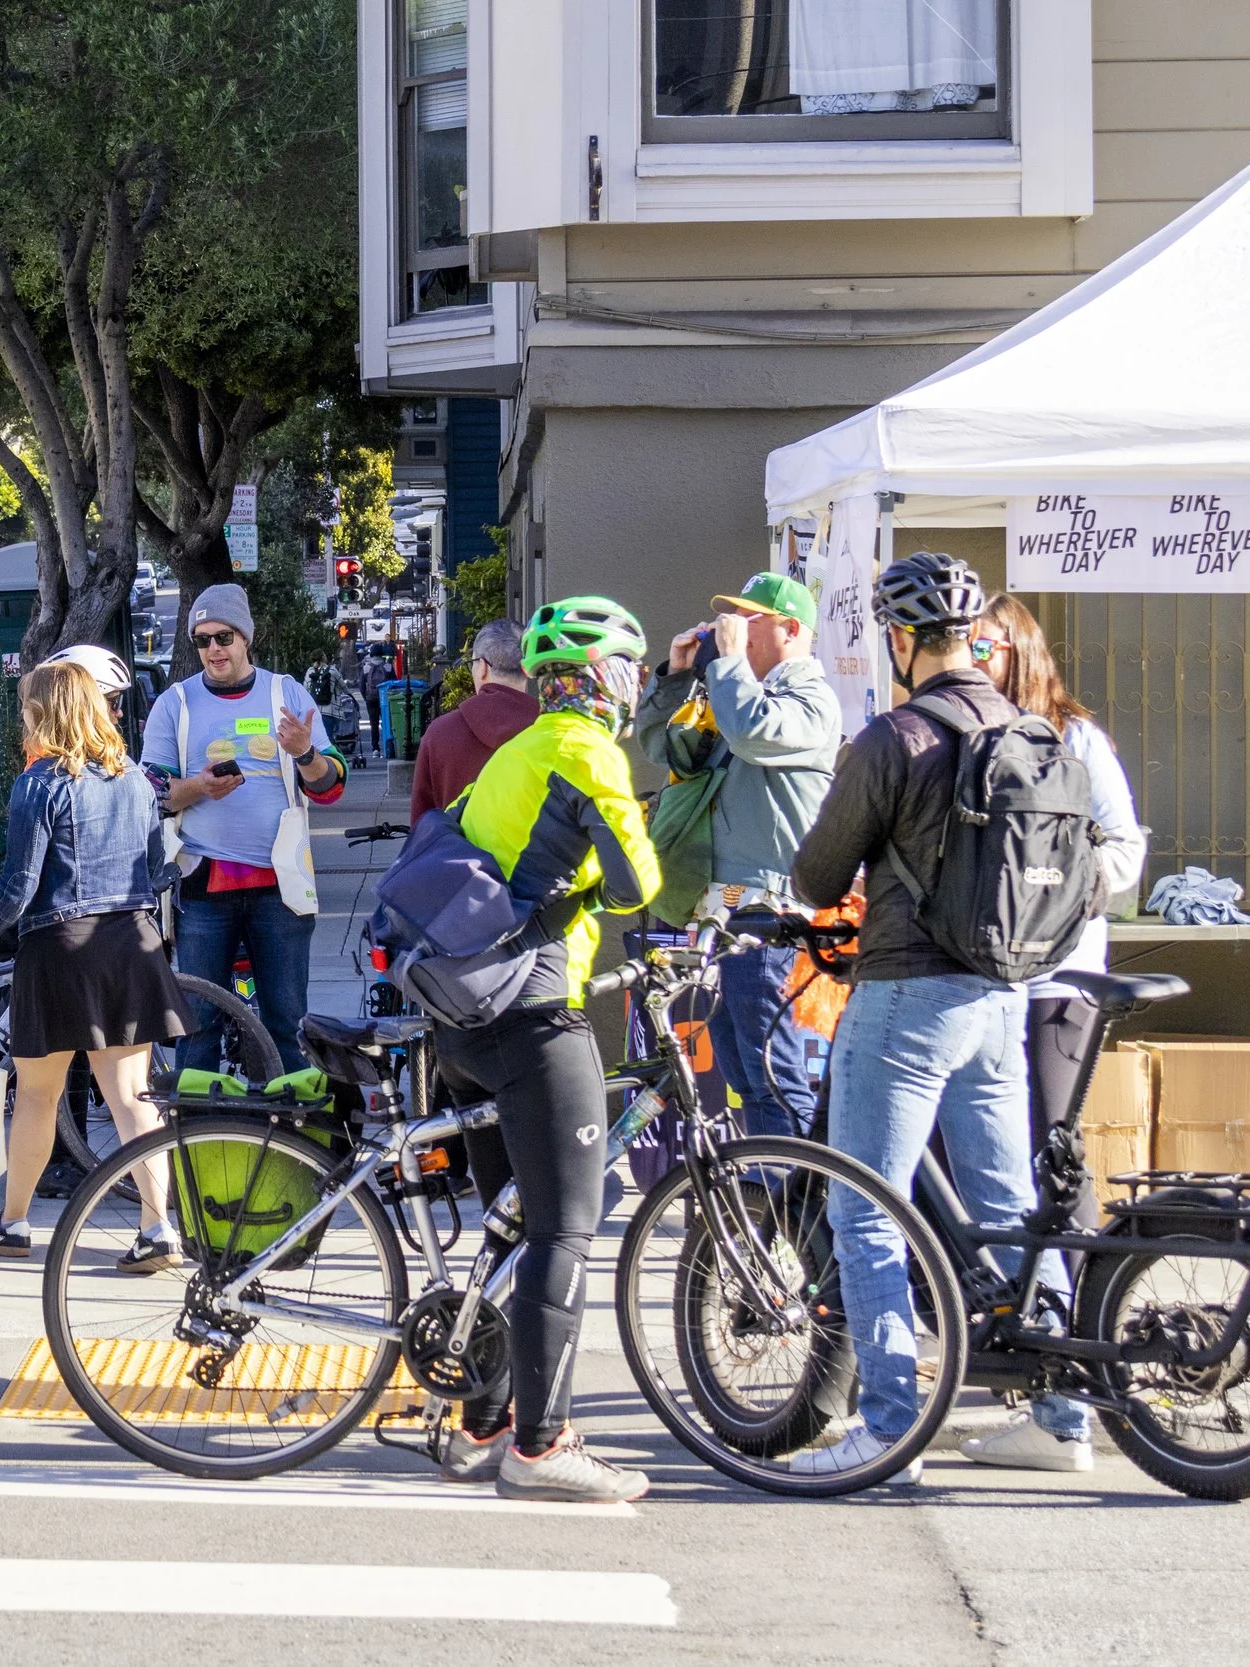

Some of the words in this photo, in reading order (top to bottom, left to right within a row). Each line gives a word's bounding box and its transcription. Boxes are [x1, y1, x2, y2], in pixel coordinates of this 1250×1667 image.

[1036, 495, 1087, 512] BIKE
[1169, 495, 1221, 513] BIKE
[1070, 509, 1096, 532] TO
[1203, 510, 1231, 532] TO
[1018, 527, 1137, 556] WHEREVER
[1152, 529, 1250, 557] WHEREVE
[1061, 551, 1106, 574] DAY
[1195, 551, 1241, 575] DAY
